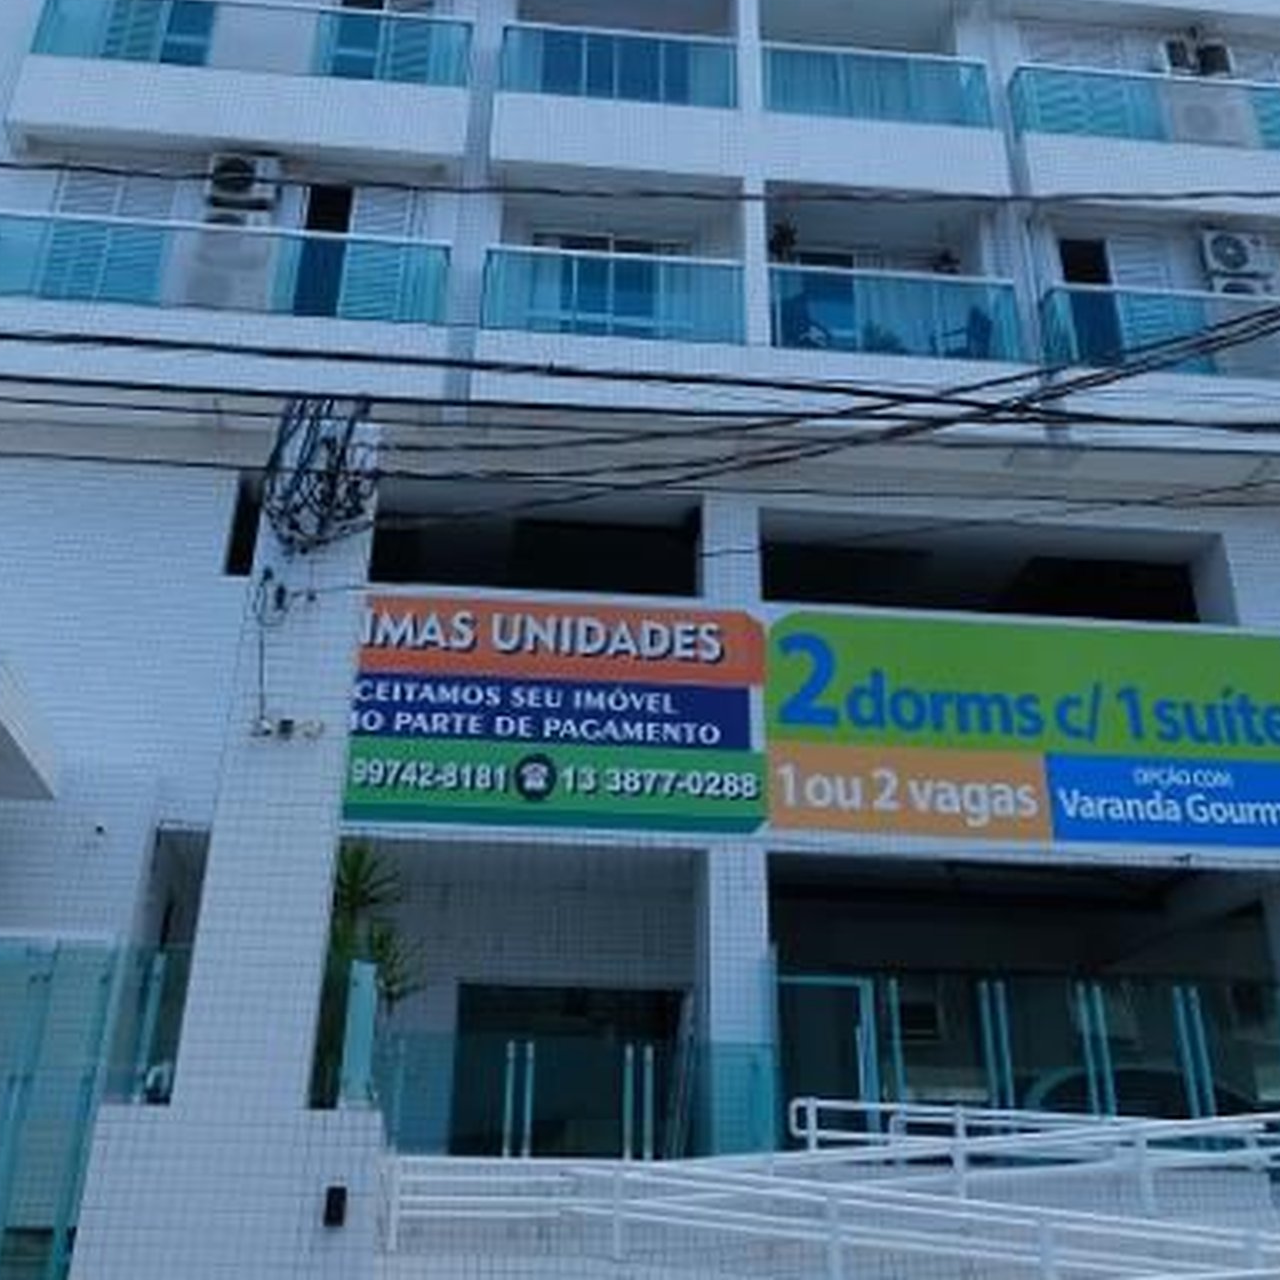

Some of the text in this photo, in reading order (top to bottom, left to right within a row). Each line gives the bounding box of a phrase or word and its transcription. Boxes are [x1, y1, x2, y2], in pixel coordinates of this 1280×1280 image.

[491, 612, 724, 663] UNIDADES
[509, 685, 563, 708] SEU
[574, 686, 679, 714] IMÓVEL
[778, 632, 839, 727] 2
[846, 667, 1045, 737] dorms
[394, 711, 483, 734] PARTE
[494, 715, 535, 737] DE
[543, 717, 722, 745] PAGAMENTO
[804, 774, 862, 810] ou
[872, 767, 900, 811] 2
[907, 776, 1039, 828] vagas
[1057, 787, 1182, 822] Varanda
